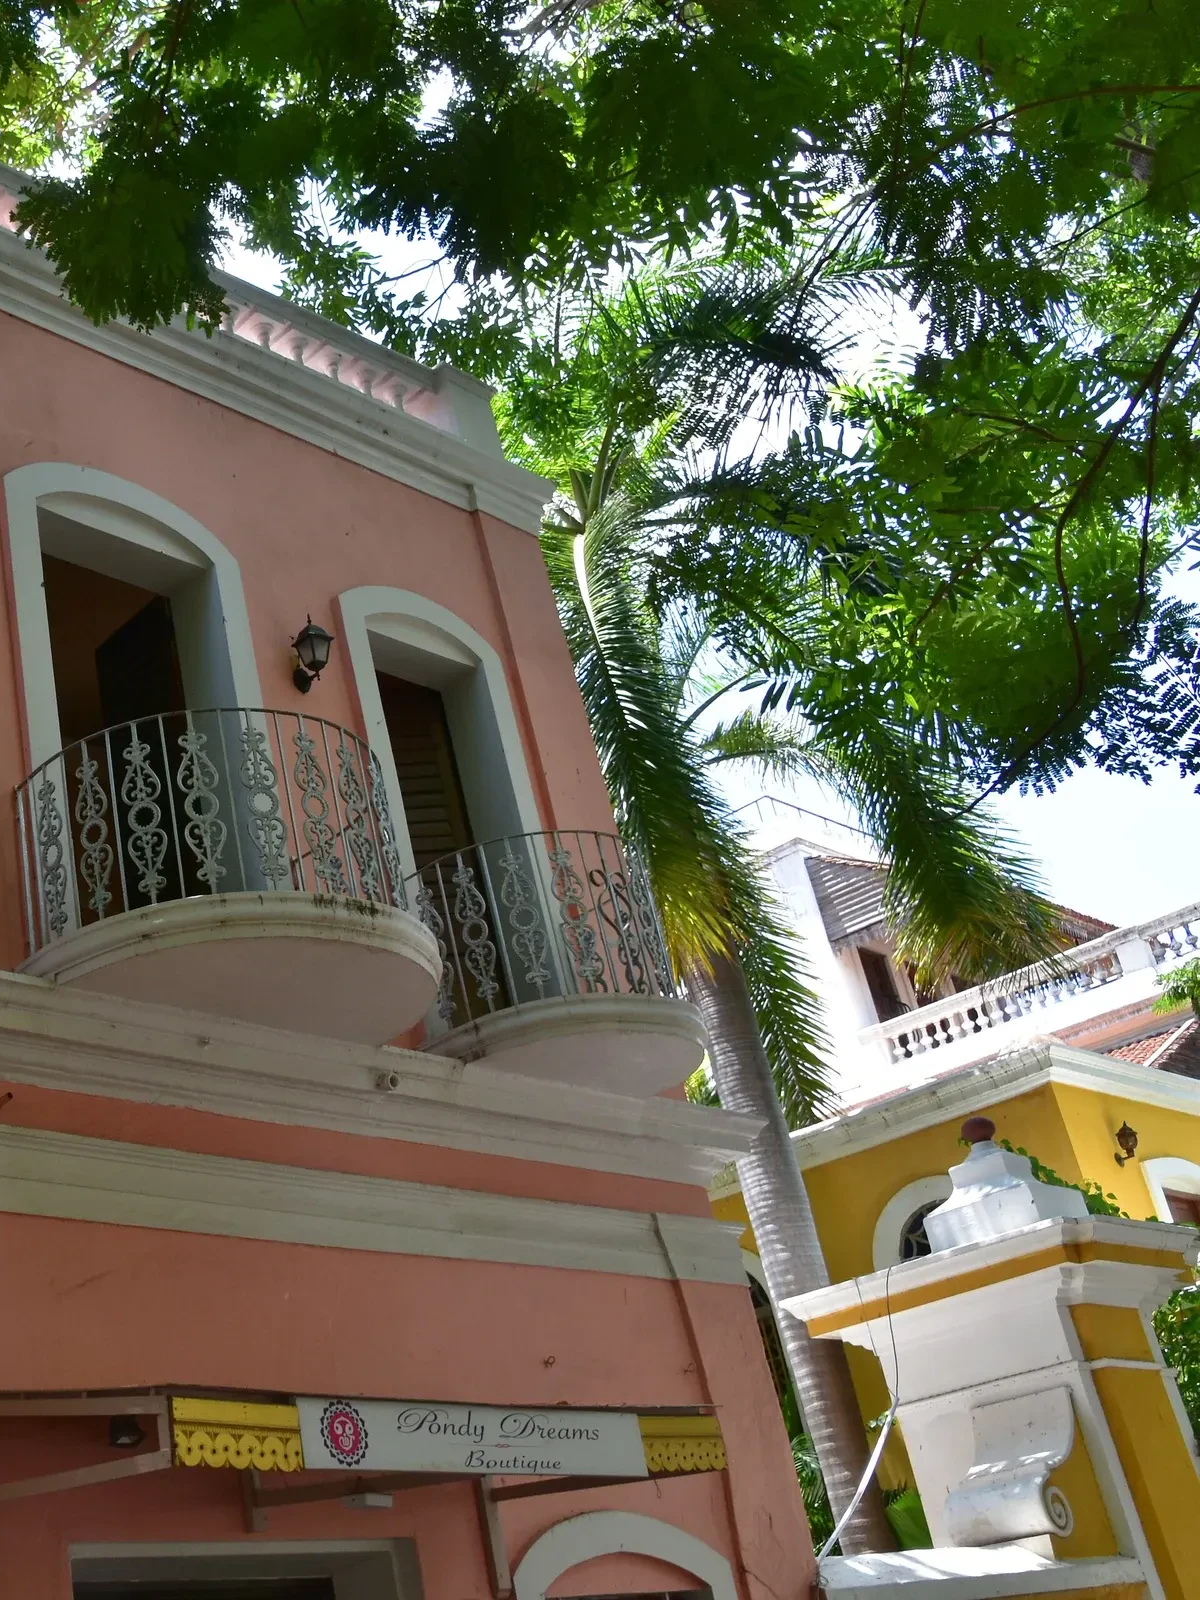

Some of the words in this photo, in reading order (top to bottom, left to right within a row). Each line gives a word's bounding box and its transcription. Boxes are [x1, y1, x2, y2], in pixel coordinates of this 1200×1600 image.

[397, 1407, 485, 1443] Pondy
[499, 1412, 599, 1441] Dreams
[464, 1449, 562, 1473] Boutique
